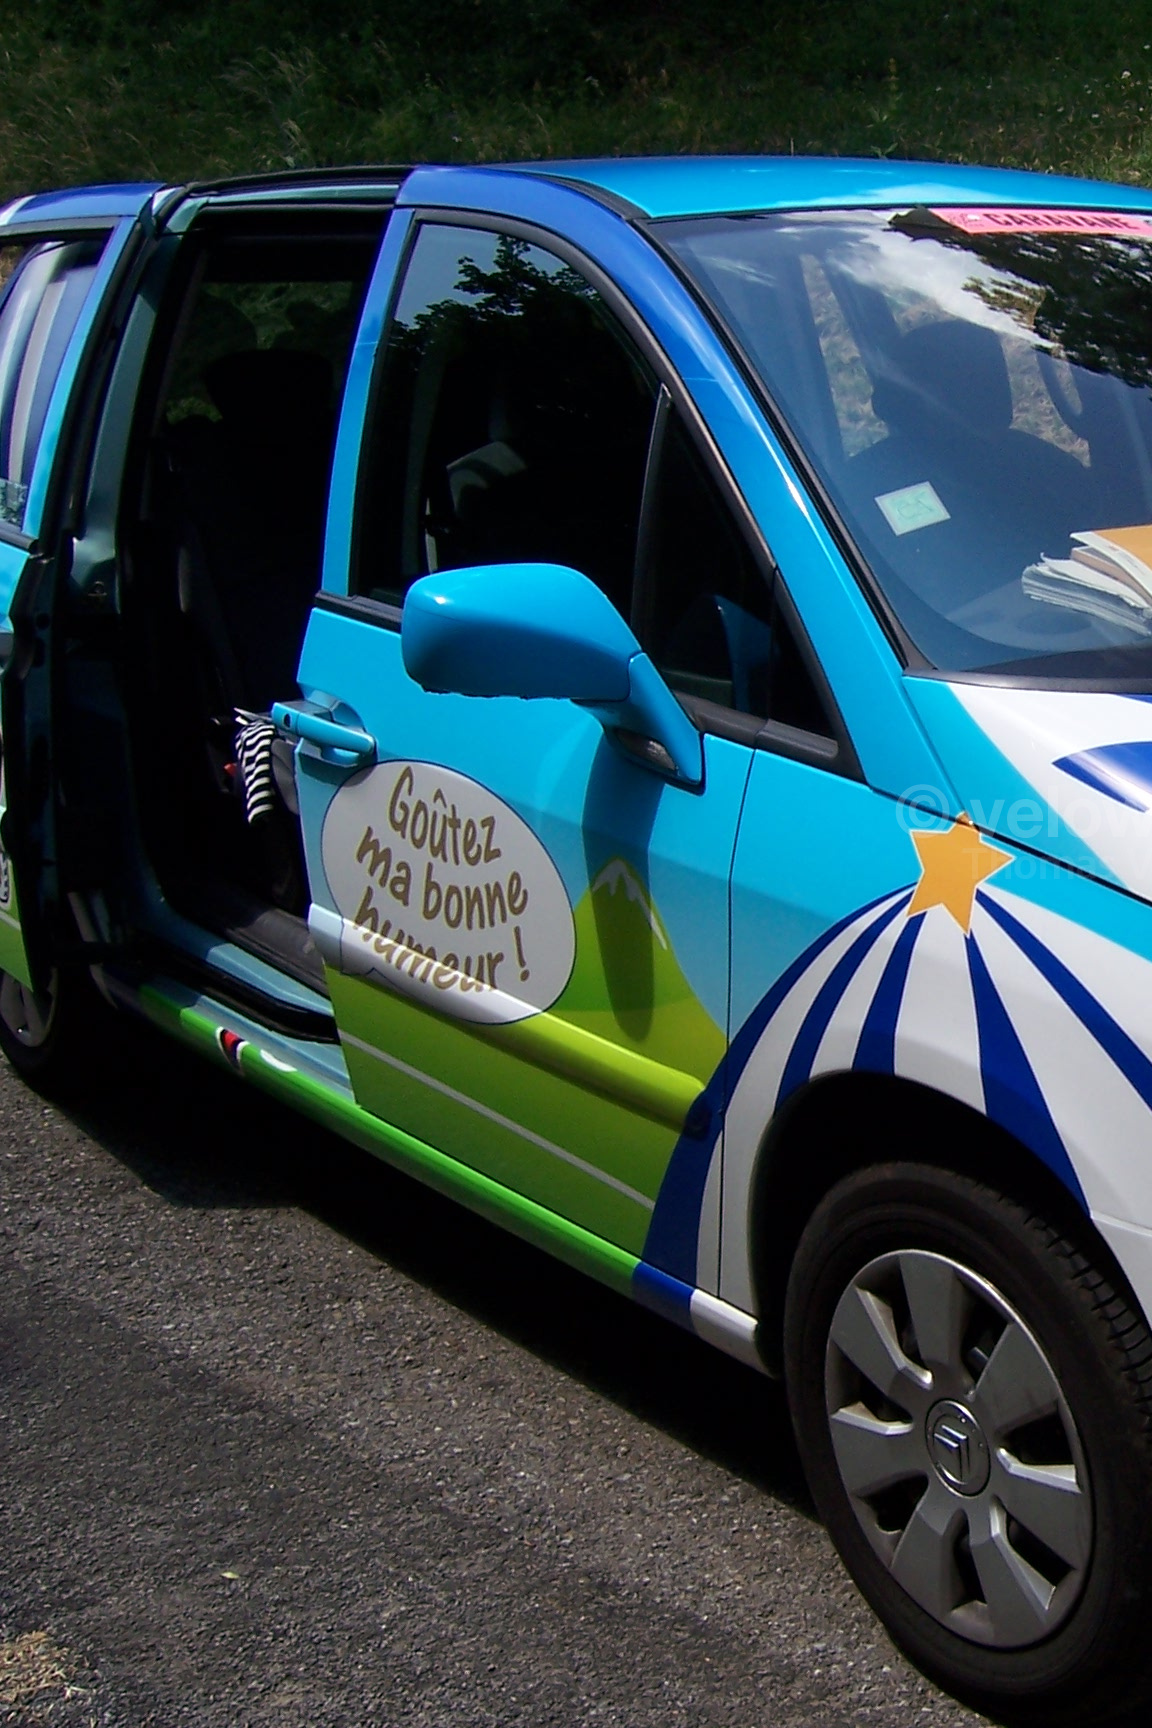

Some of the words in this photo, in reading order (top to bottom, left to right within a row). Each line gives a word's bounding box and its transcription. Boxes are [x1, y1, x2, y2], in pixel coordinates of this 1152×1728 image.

[982, 212, 1141, 231] CARAVANE
[388, 766, 502, 866] Goûtez
[356, 826, 411, 907] ma
[423, 862, 528, 928] bonne
[353, 886, 504, 992] humeur
